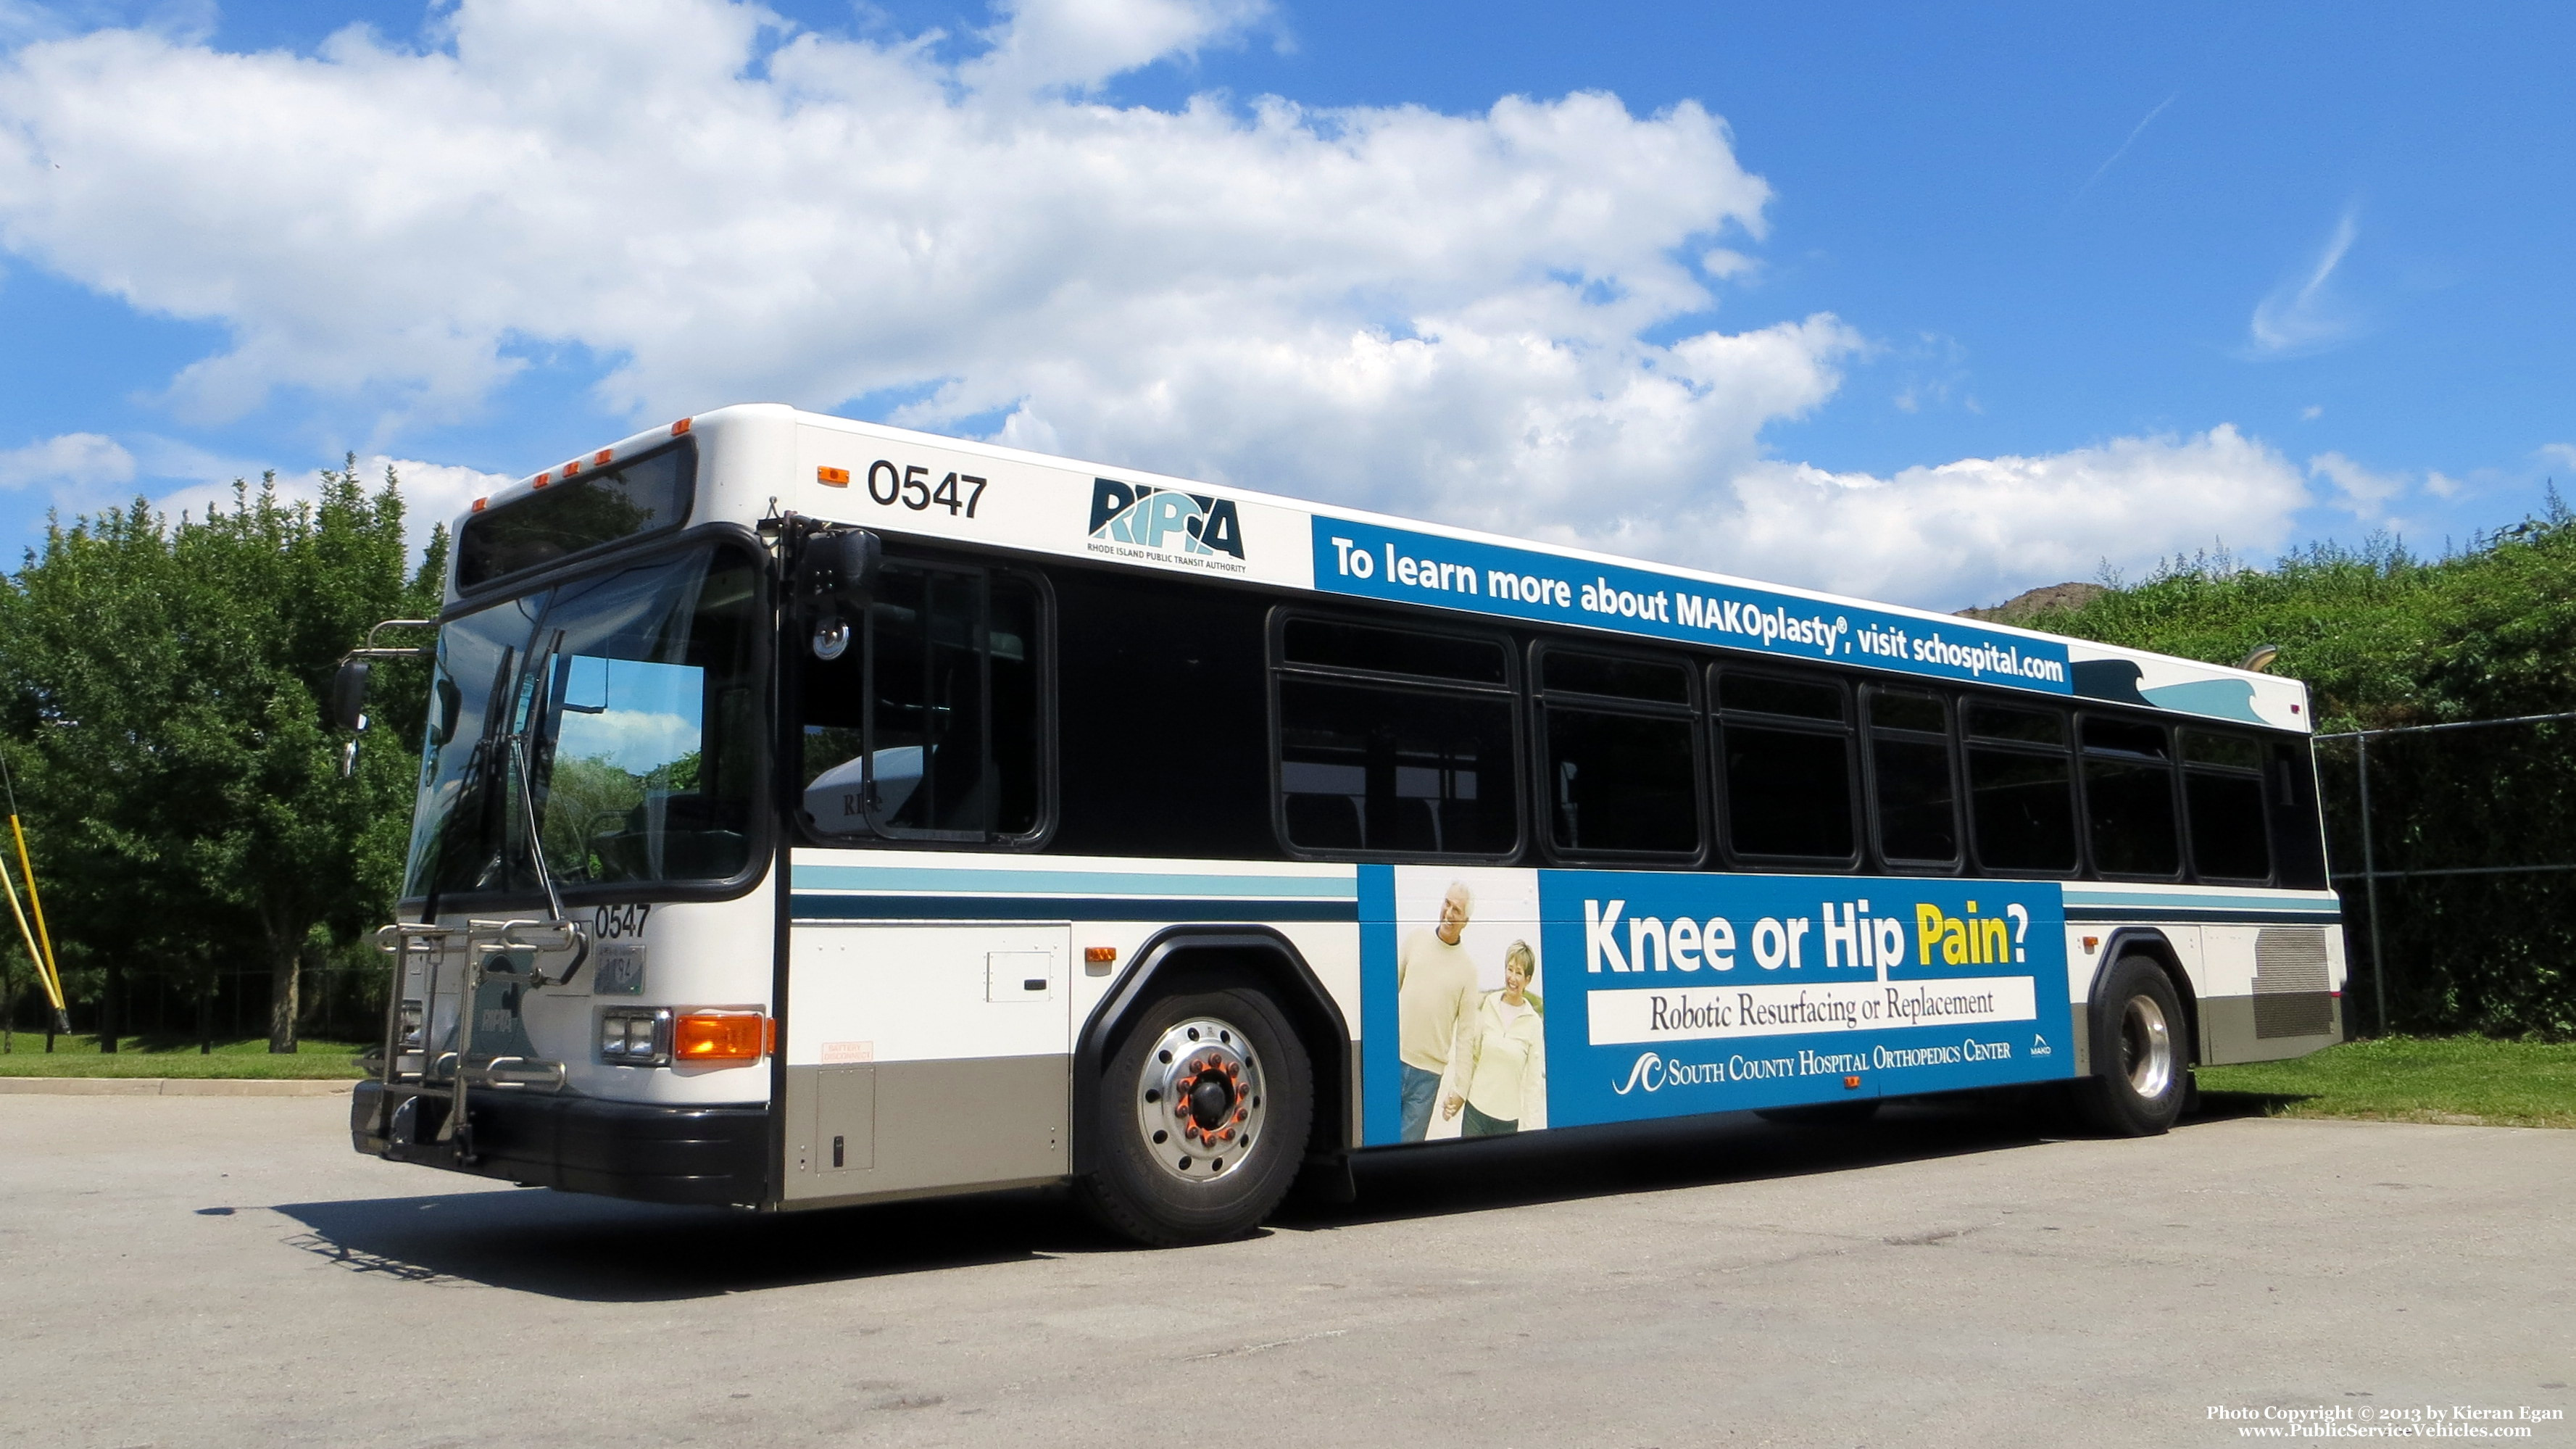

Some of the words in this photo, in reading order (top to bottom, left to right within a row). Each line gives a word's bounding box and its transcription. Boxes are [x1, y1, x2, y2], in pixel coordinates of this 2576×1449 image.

[868, 460, 987, 519] 0547
[1089, 477, 1246, 561] RIPTA
[1087, 543, 1114, 555] RHODE
[1116, 547, 1144, 559] ISLAND
[1147, 552, 1173, 563] PUBLIC
[1174, 555, 1204, 568] TRANSIT
[1205, 560, 1246, 573] AUTHORITY
[1331, 536, 1374, 579] To
[1385, 543, 1478, 595] learn
[1488, 569, 1571, 608] more
[1580, 577, 1669, 623] about
[1857, 623, 1908, 658] visit
[1913, 633, 2064, 683] schospital.com
[595, 903, 651, 939] 0547
[1584, 899, 1735, 973] Knee
[1752, 916, 1809, 970] or
[1822, 899, 1905, 981] Hip
[1915, 900, 2029, 966] Pain?
[1650, 992, 1732, 1031] Robotic
[1738, 989, 1857, 1028] Resurfacing
[1862, 1000, 1881, 1021] or
[1885, 987, 1995, 1025] Replacement
[1669, 1059, 1725, 1086] SOUTH
[1729, 1055, 1795, 1081] COUNTY
[1799, 1050, 1870, 1076] HOSPITAL
[1873, 1045, 1961, 1069] ORTHOPEDICS
[1964, 1038, 2012, 1061] CENTER
